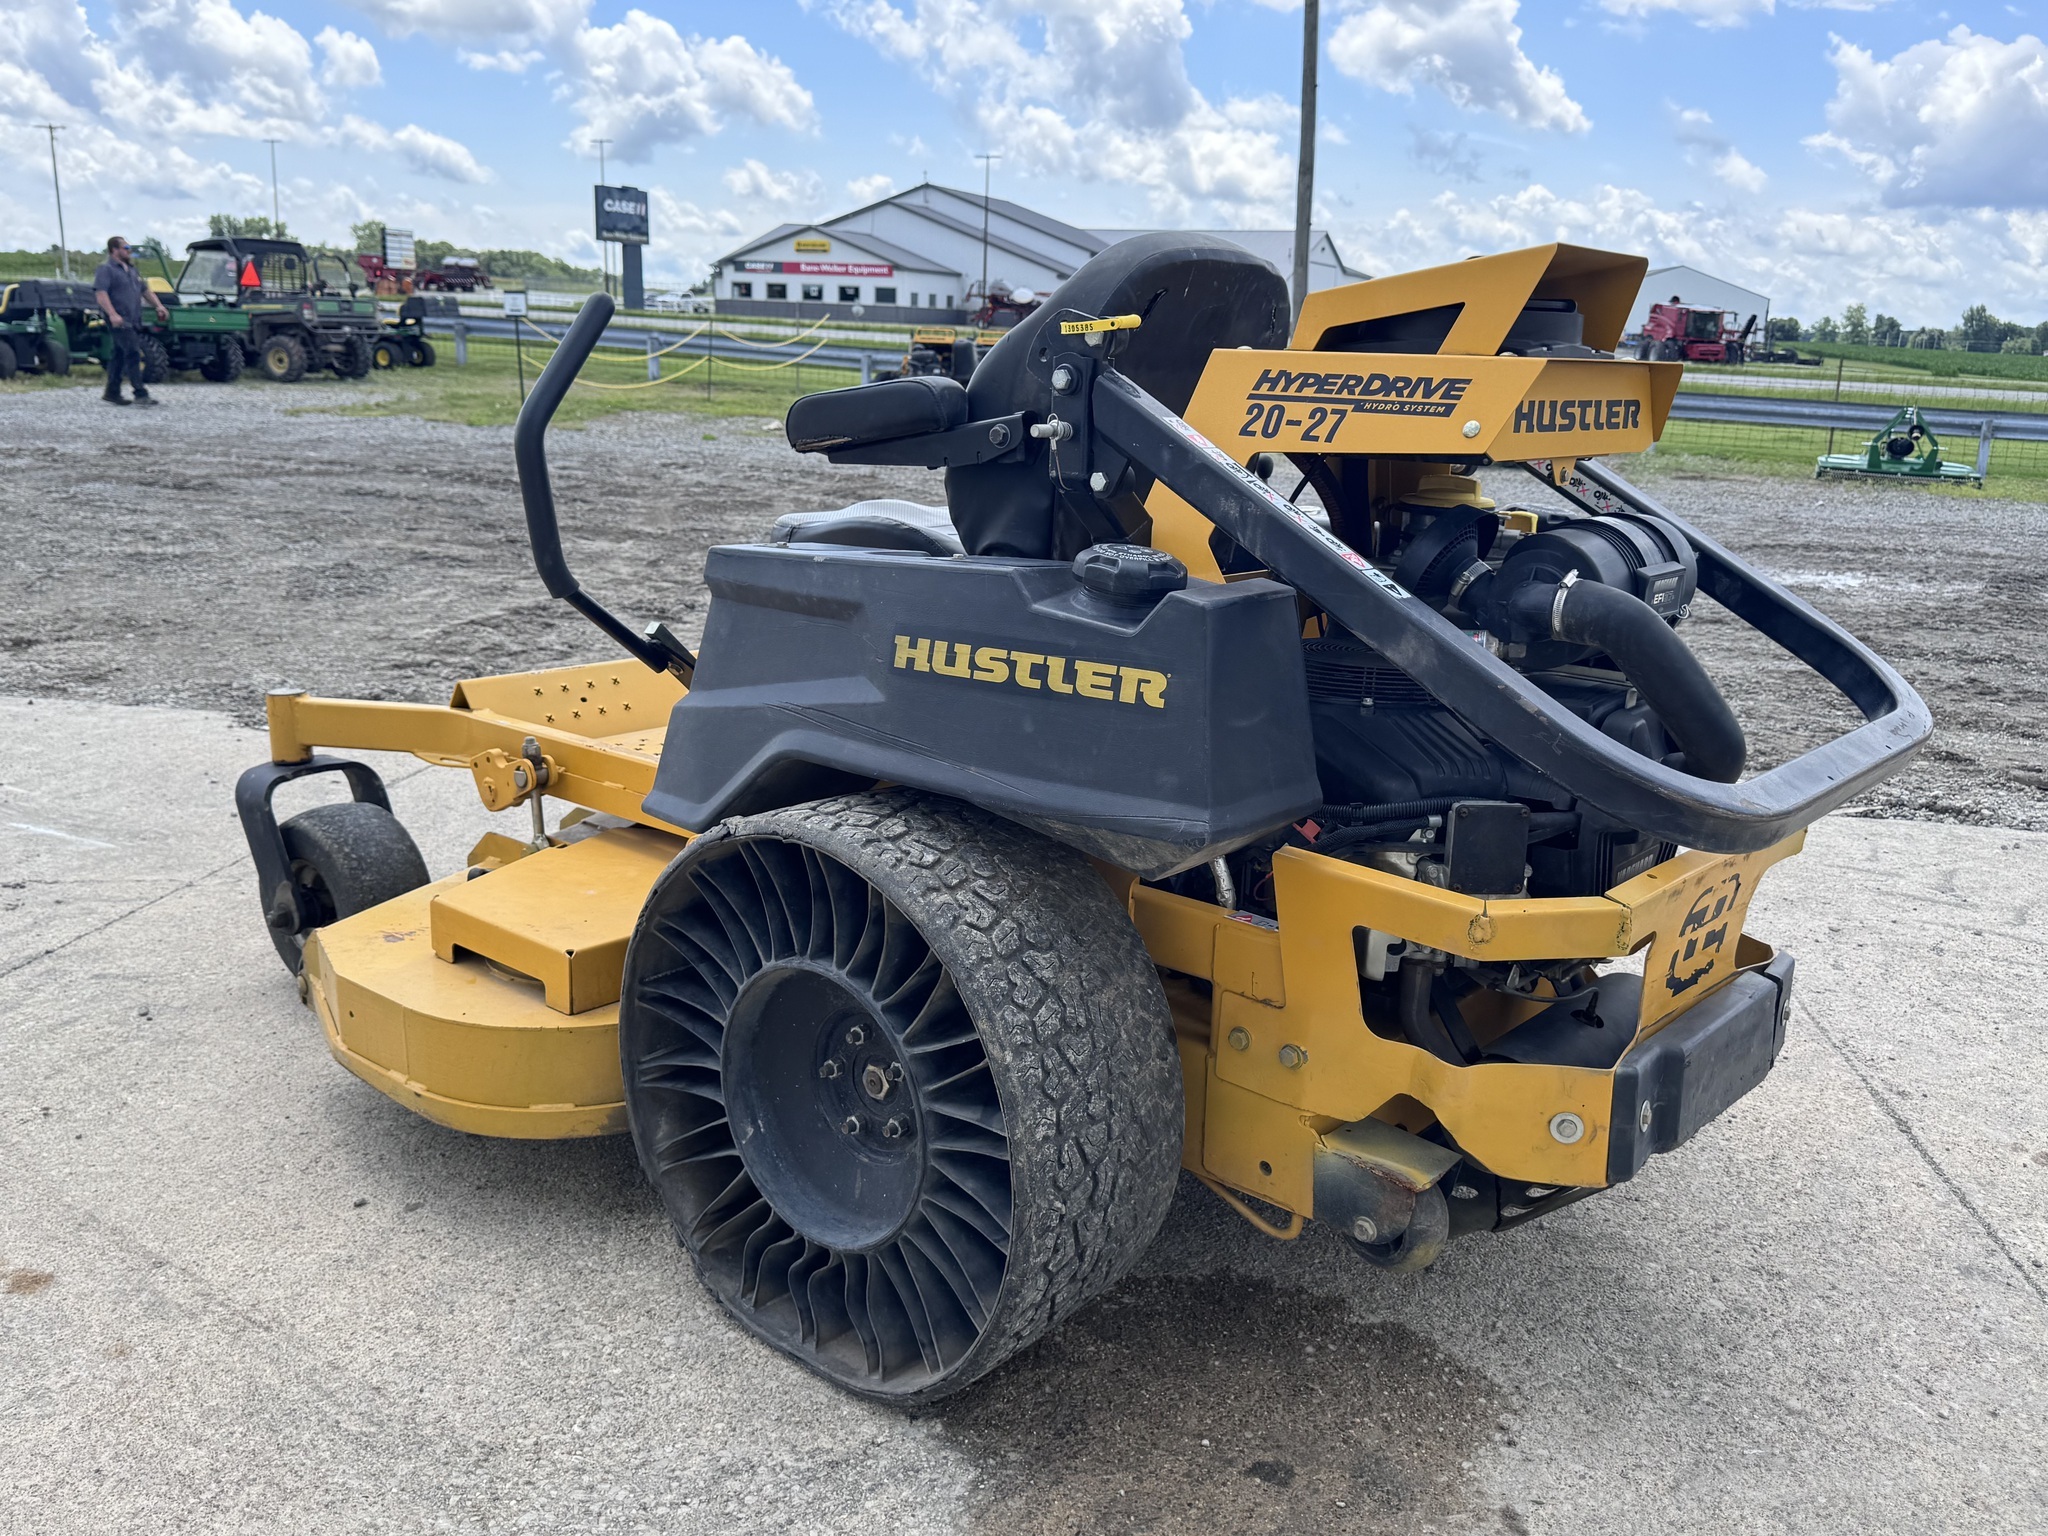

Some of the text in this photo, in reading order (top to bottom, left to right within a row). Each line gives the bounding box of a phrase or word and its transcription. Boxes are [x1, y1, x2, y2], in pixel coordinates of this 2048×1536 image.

[603, 198, 635, 215] CASE
[848, 265, 889, 276] Equipment
[1251, 369, 1473, 401] HYPERDRIVE
[1363, 402, 1446, 414] HYDRO SYSTEM
[1512, 399, 1641, 433] HUSTLER
[1238, 402, 1349, 444] 20-27
[1653, 593, 1665, 604] EFI
[893, 634, 1170, 709] HUSTLER
